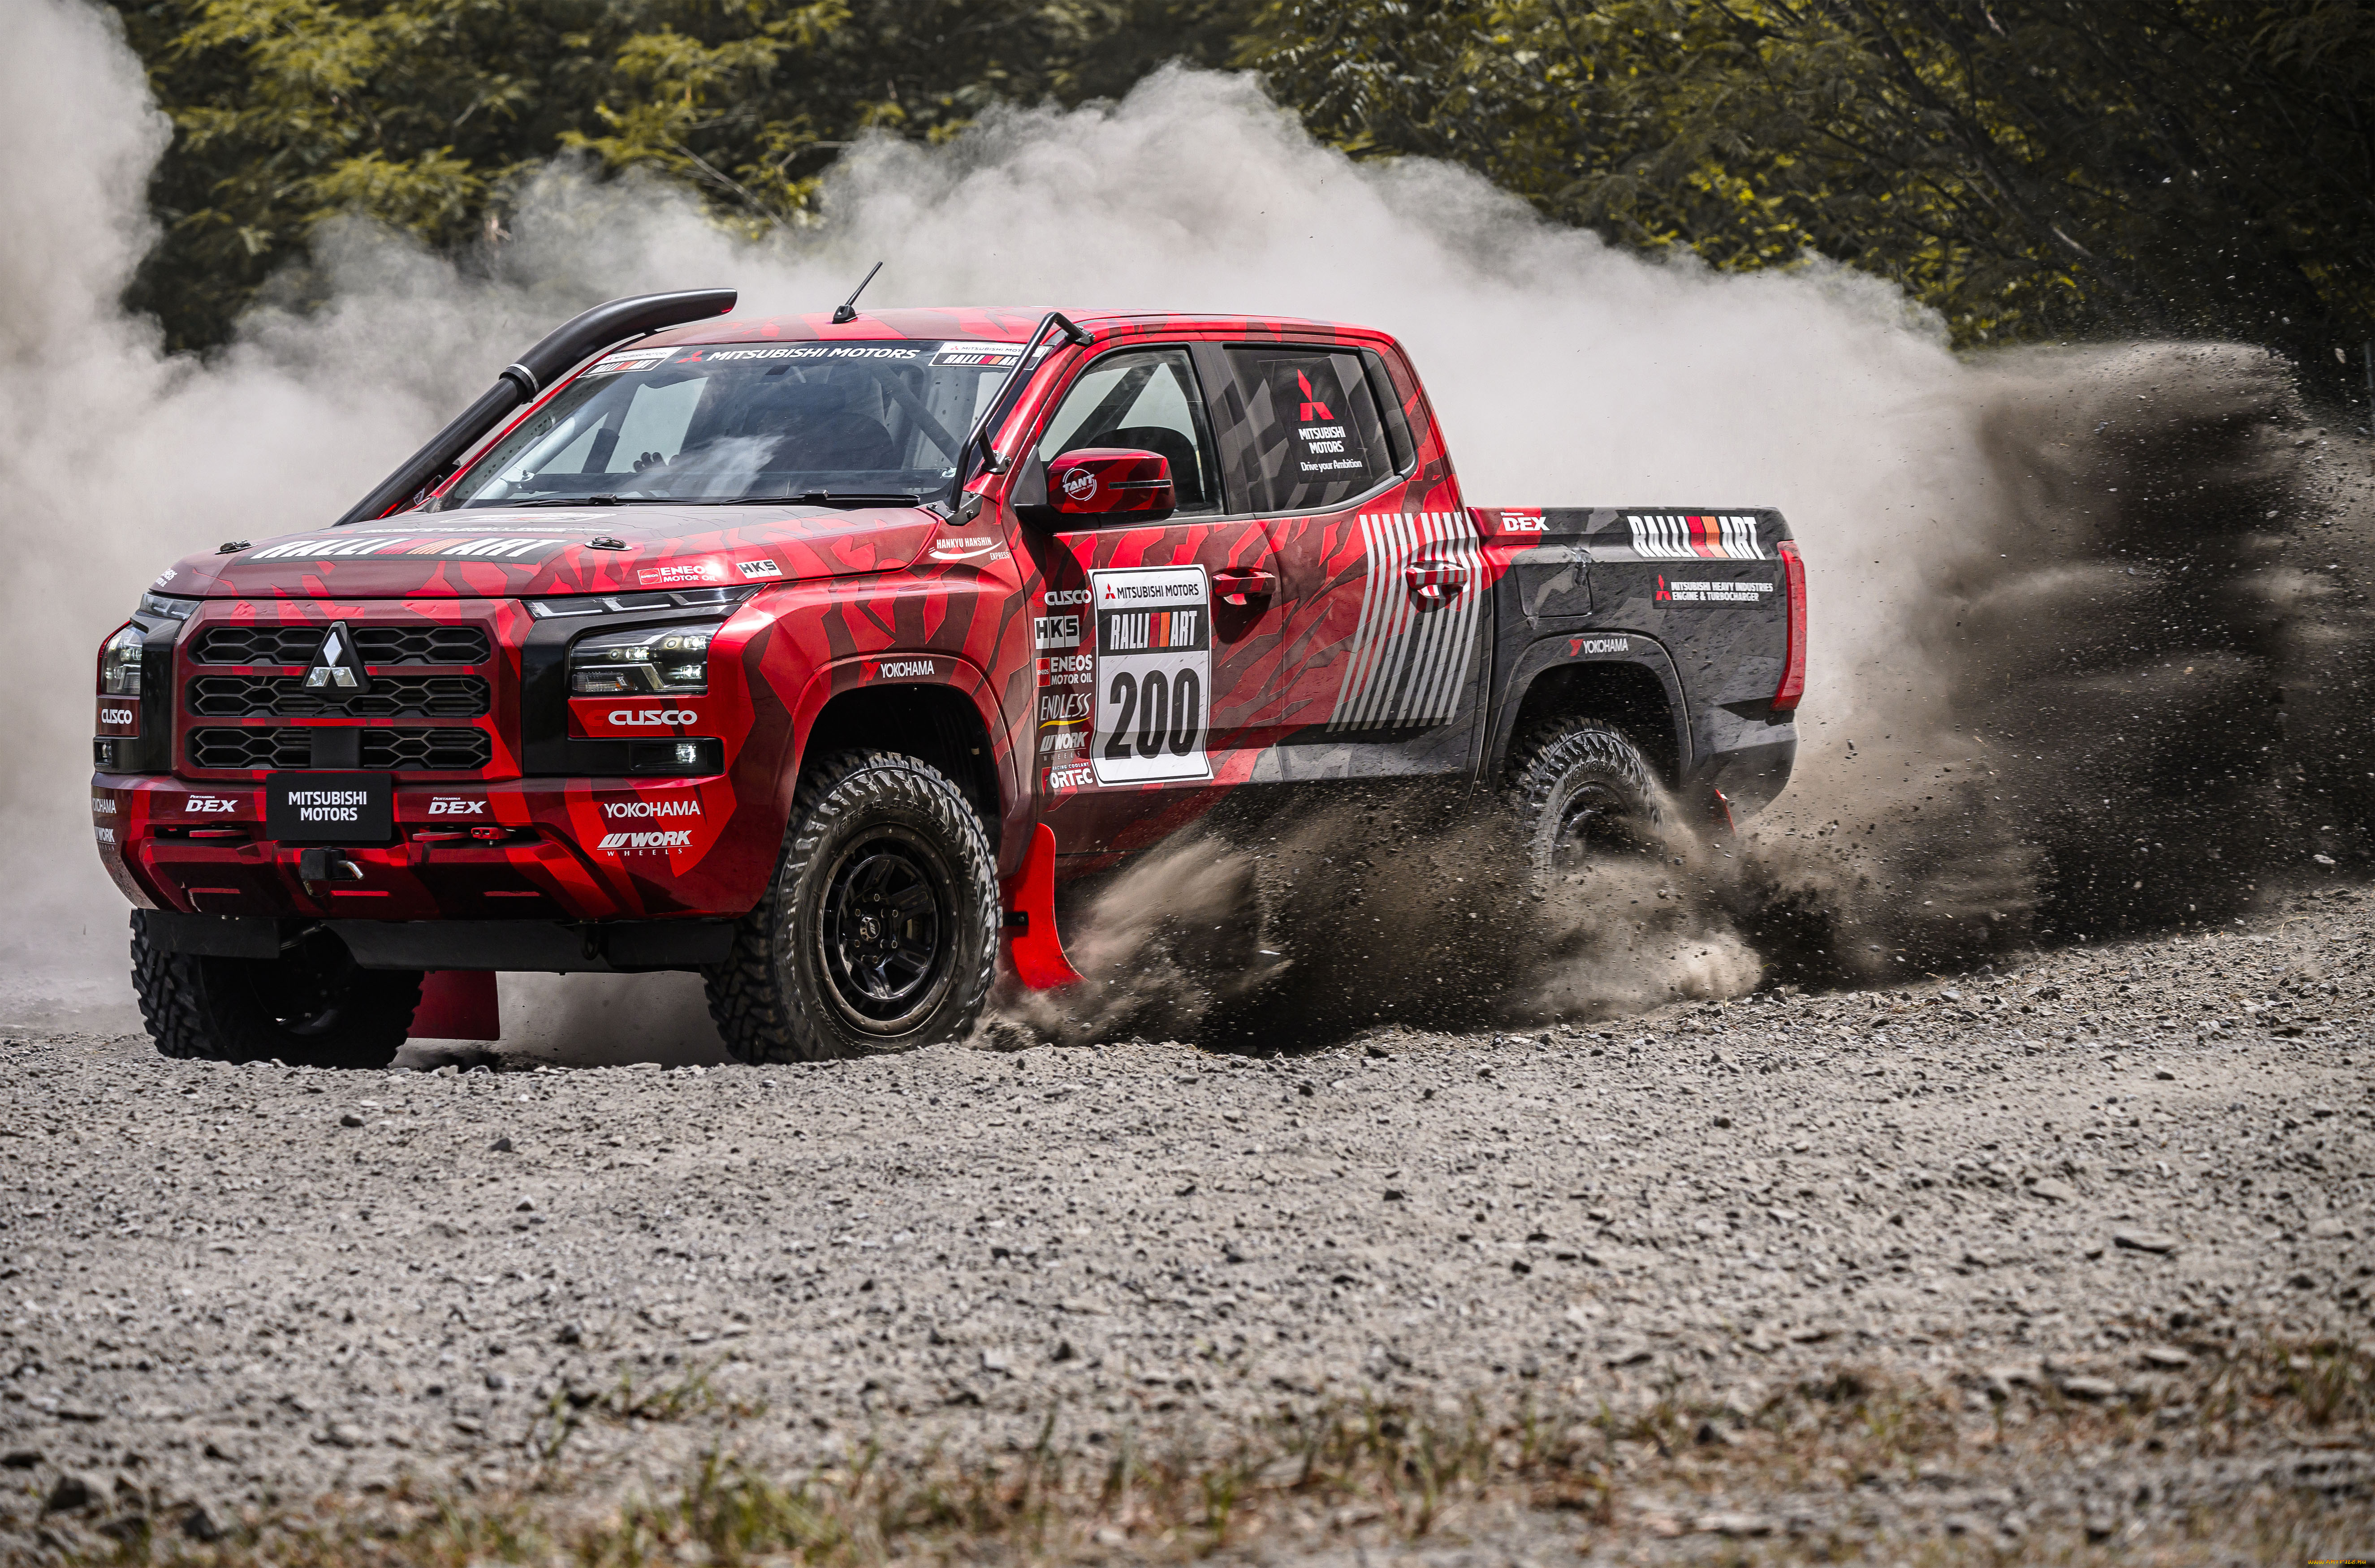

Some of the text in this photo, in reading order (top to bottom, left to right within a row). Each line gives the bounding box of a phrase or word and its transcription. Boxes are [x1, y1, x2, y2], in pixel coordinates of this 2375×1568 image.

[707, 348, 920, 361] MITSUBISHI MOTORS
[942, 354, 1019, 366] RALLIAR
[1298, 426, 1346, 440] MITSUBISHI
[1308, 440, 1344, 454] MOTORS
[1300, 459, 1363, 473] Drive your Ambition
[1062, 474, 1095, 492] TANT
[1502, 517, 1550, 531] DEX
[937, 537, 992, 549] HANKYU HANSHIN
[990, 551, 1010, 560] EXPRESS
[738, 560, 777, 574] HKS
[1117, 583, 1199, 599] MITSUBISHI MOTORS
[1671, 582, 1774, 592] MITSUBISHI HEAVY INDUSTRIES
[1044, 589, 1092, 606] CUSCO
[1671, 591, 1760, 601] ENGINE & TURBOCHARGER
[1035, 616, 1079, 641] HKS
[1583, 638, 1628, 654] YOKOHAMA
[880, 660, 934, 679] YOKOHAMA
[1051, 654, 1092, 672] ENEOS
[1051, 672, 1092, 685] MOTOR OIL
[1041, 693, 1092, 721] ENDLESS
[1105, 668, 1200, 760] 200
[101, 709, 132, 724] CUSCO
[609, 710, 698, 725] CUSCO
[1054, 732, 1088, 750] WORK
[1043, 751, 1080, 761] WHEELS
[289, 791, 367, 805] MITSUBISHI
[185, 800, 238, 812] DEX
[428, 801, 487, 814] DEX
[604, 800, 700, 818] YOKOHAMA
[301, 807, 358, 821] MOTORS
[630, 830, 692, 845] WORK
[607, 848, 682, 856] WHEELS
